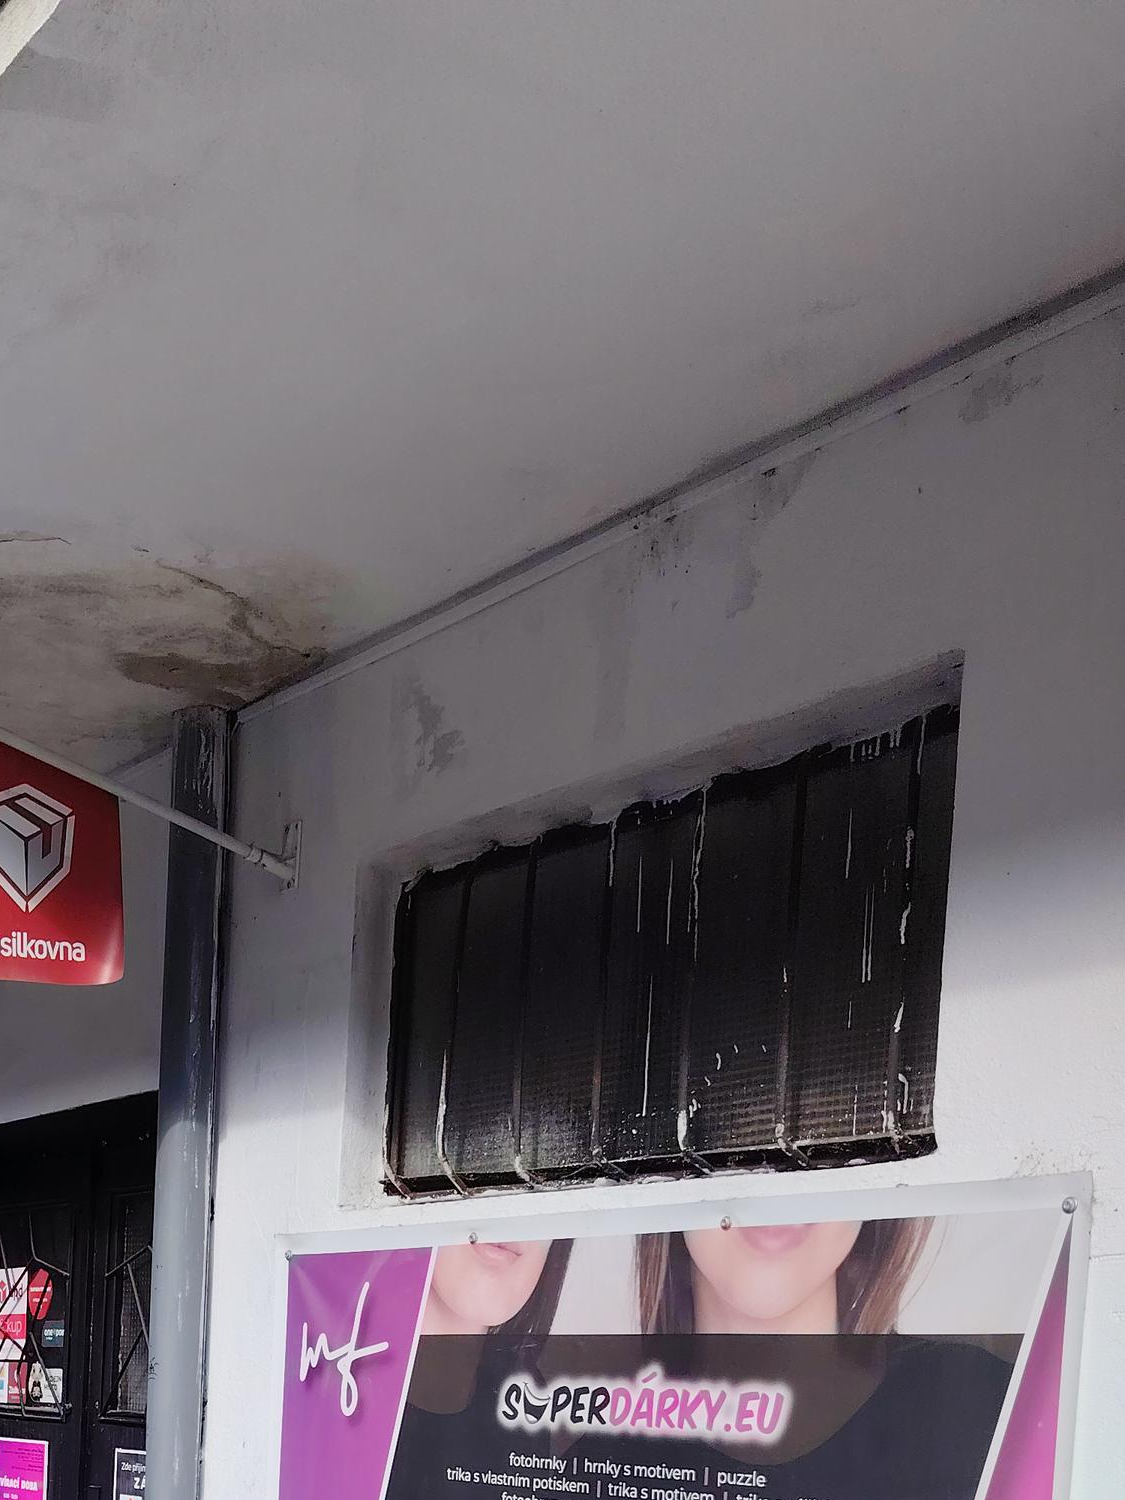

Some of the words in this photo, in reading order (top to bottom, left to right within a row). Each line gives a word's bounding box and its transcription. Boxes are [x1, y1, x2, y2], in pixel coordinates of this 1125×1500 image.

[502, 1372, 785, 1435] SUPERDÁRKY.EU
[21, 1480, 38, 1491] DOBA
[446, 1467, 471, 1482] trika
[473, 1472, 480, 1483] s
[481, 1470, 530, 1488] vlastním
[532, 1477, 590, 1495] potiskem
[608, 1483, 638, 1499] trika
[640, 1488, 649, 1500] s
[509, 1452, 567, 1474] fotohrnky
[584, 1458, 622, 1479] hrnky
[623, 1465, 631, 1477] s
[634, 1463, 696, 1482] motivem
[716, 1470, 767, 1488] puzzle
